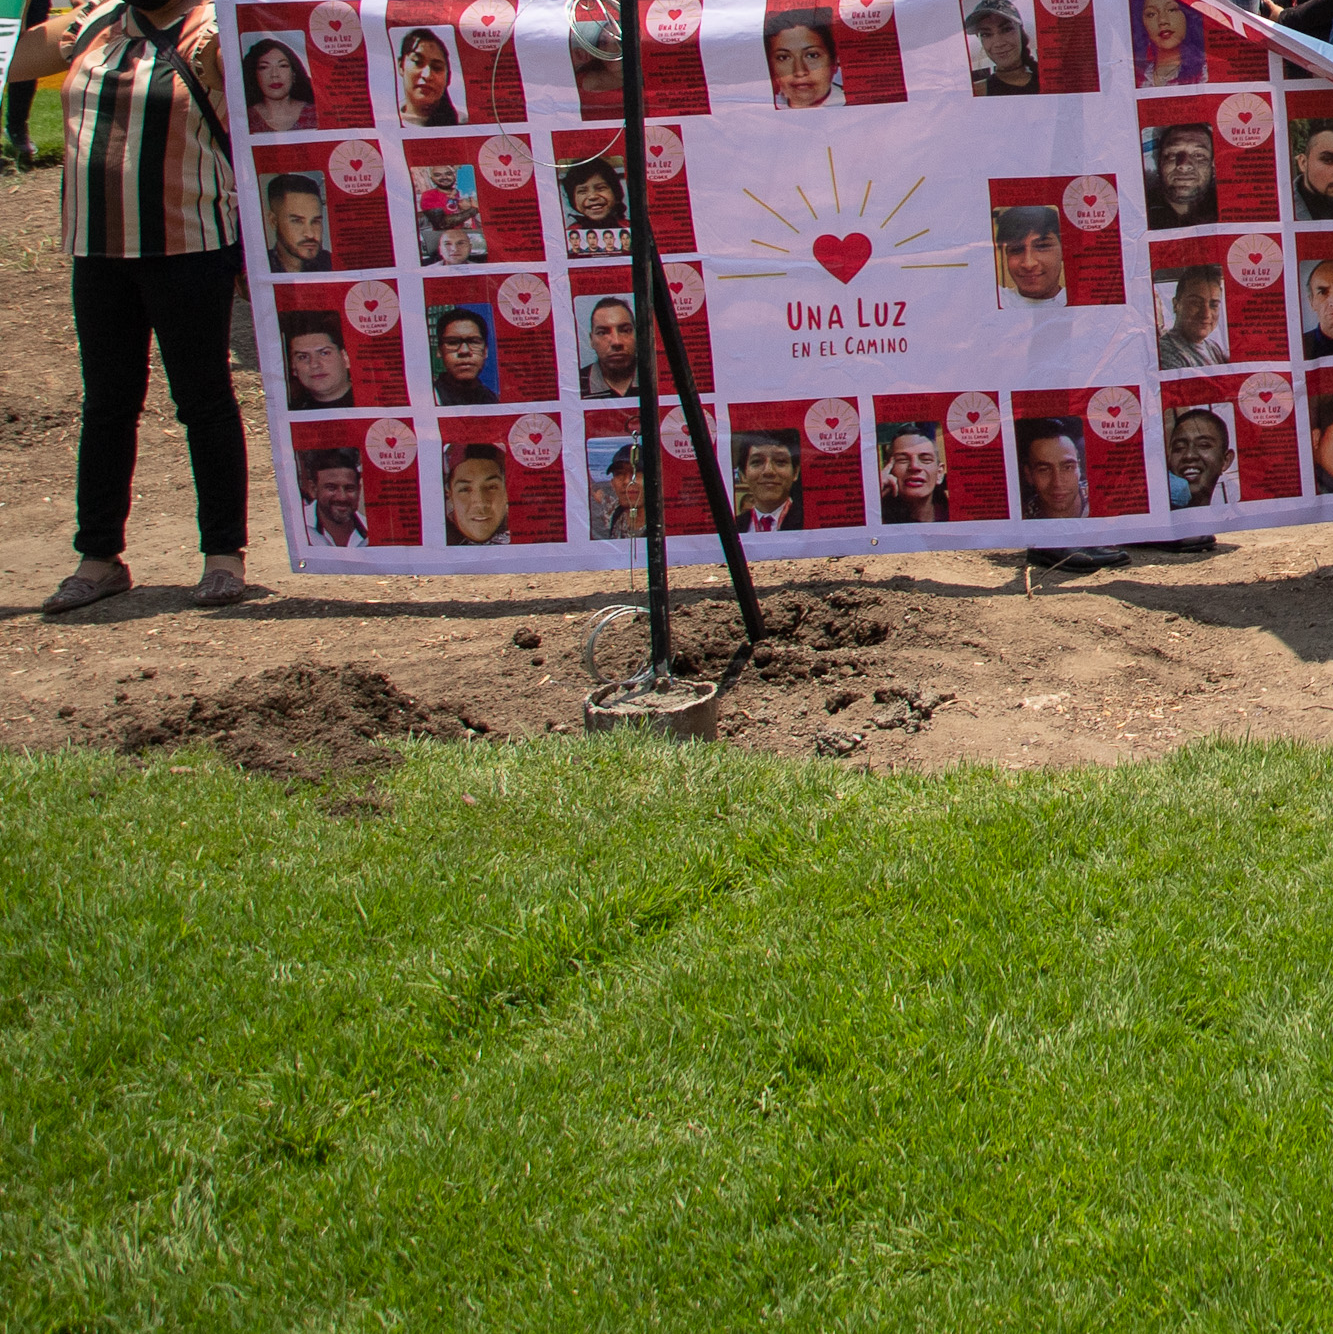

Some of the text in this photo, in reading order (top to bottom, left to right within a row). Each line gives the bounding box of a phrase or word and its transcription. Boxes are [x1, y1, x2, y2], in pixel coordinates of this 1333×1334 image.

[787, 297, 907, 331] UNA LUZ
[792, 336, 908, 358] EN EL CAMINO
